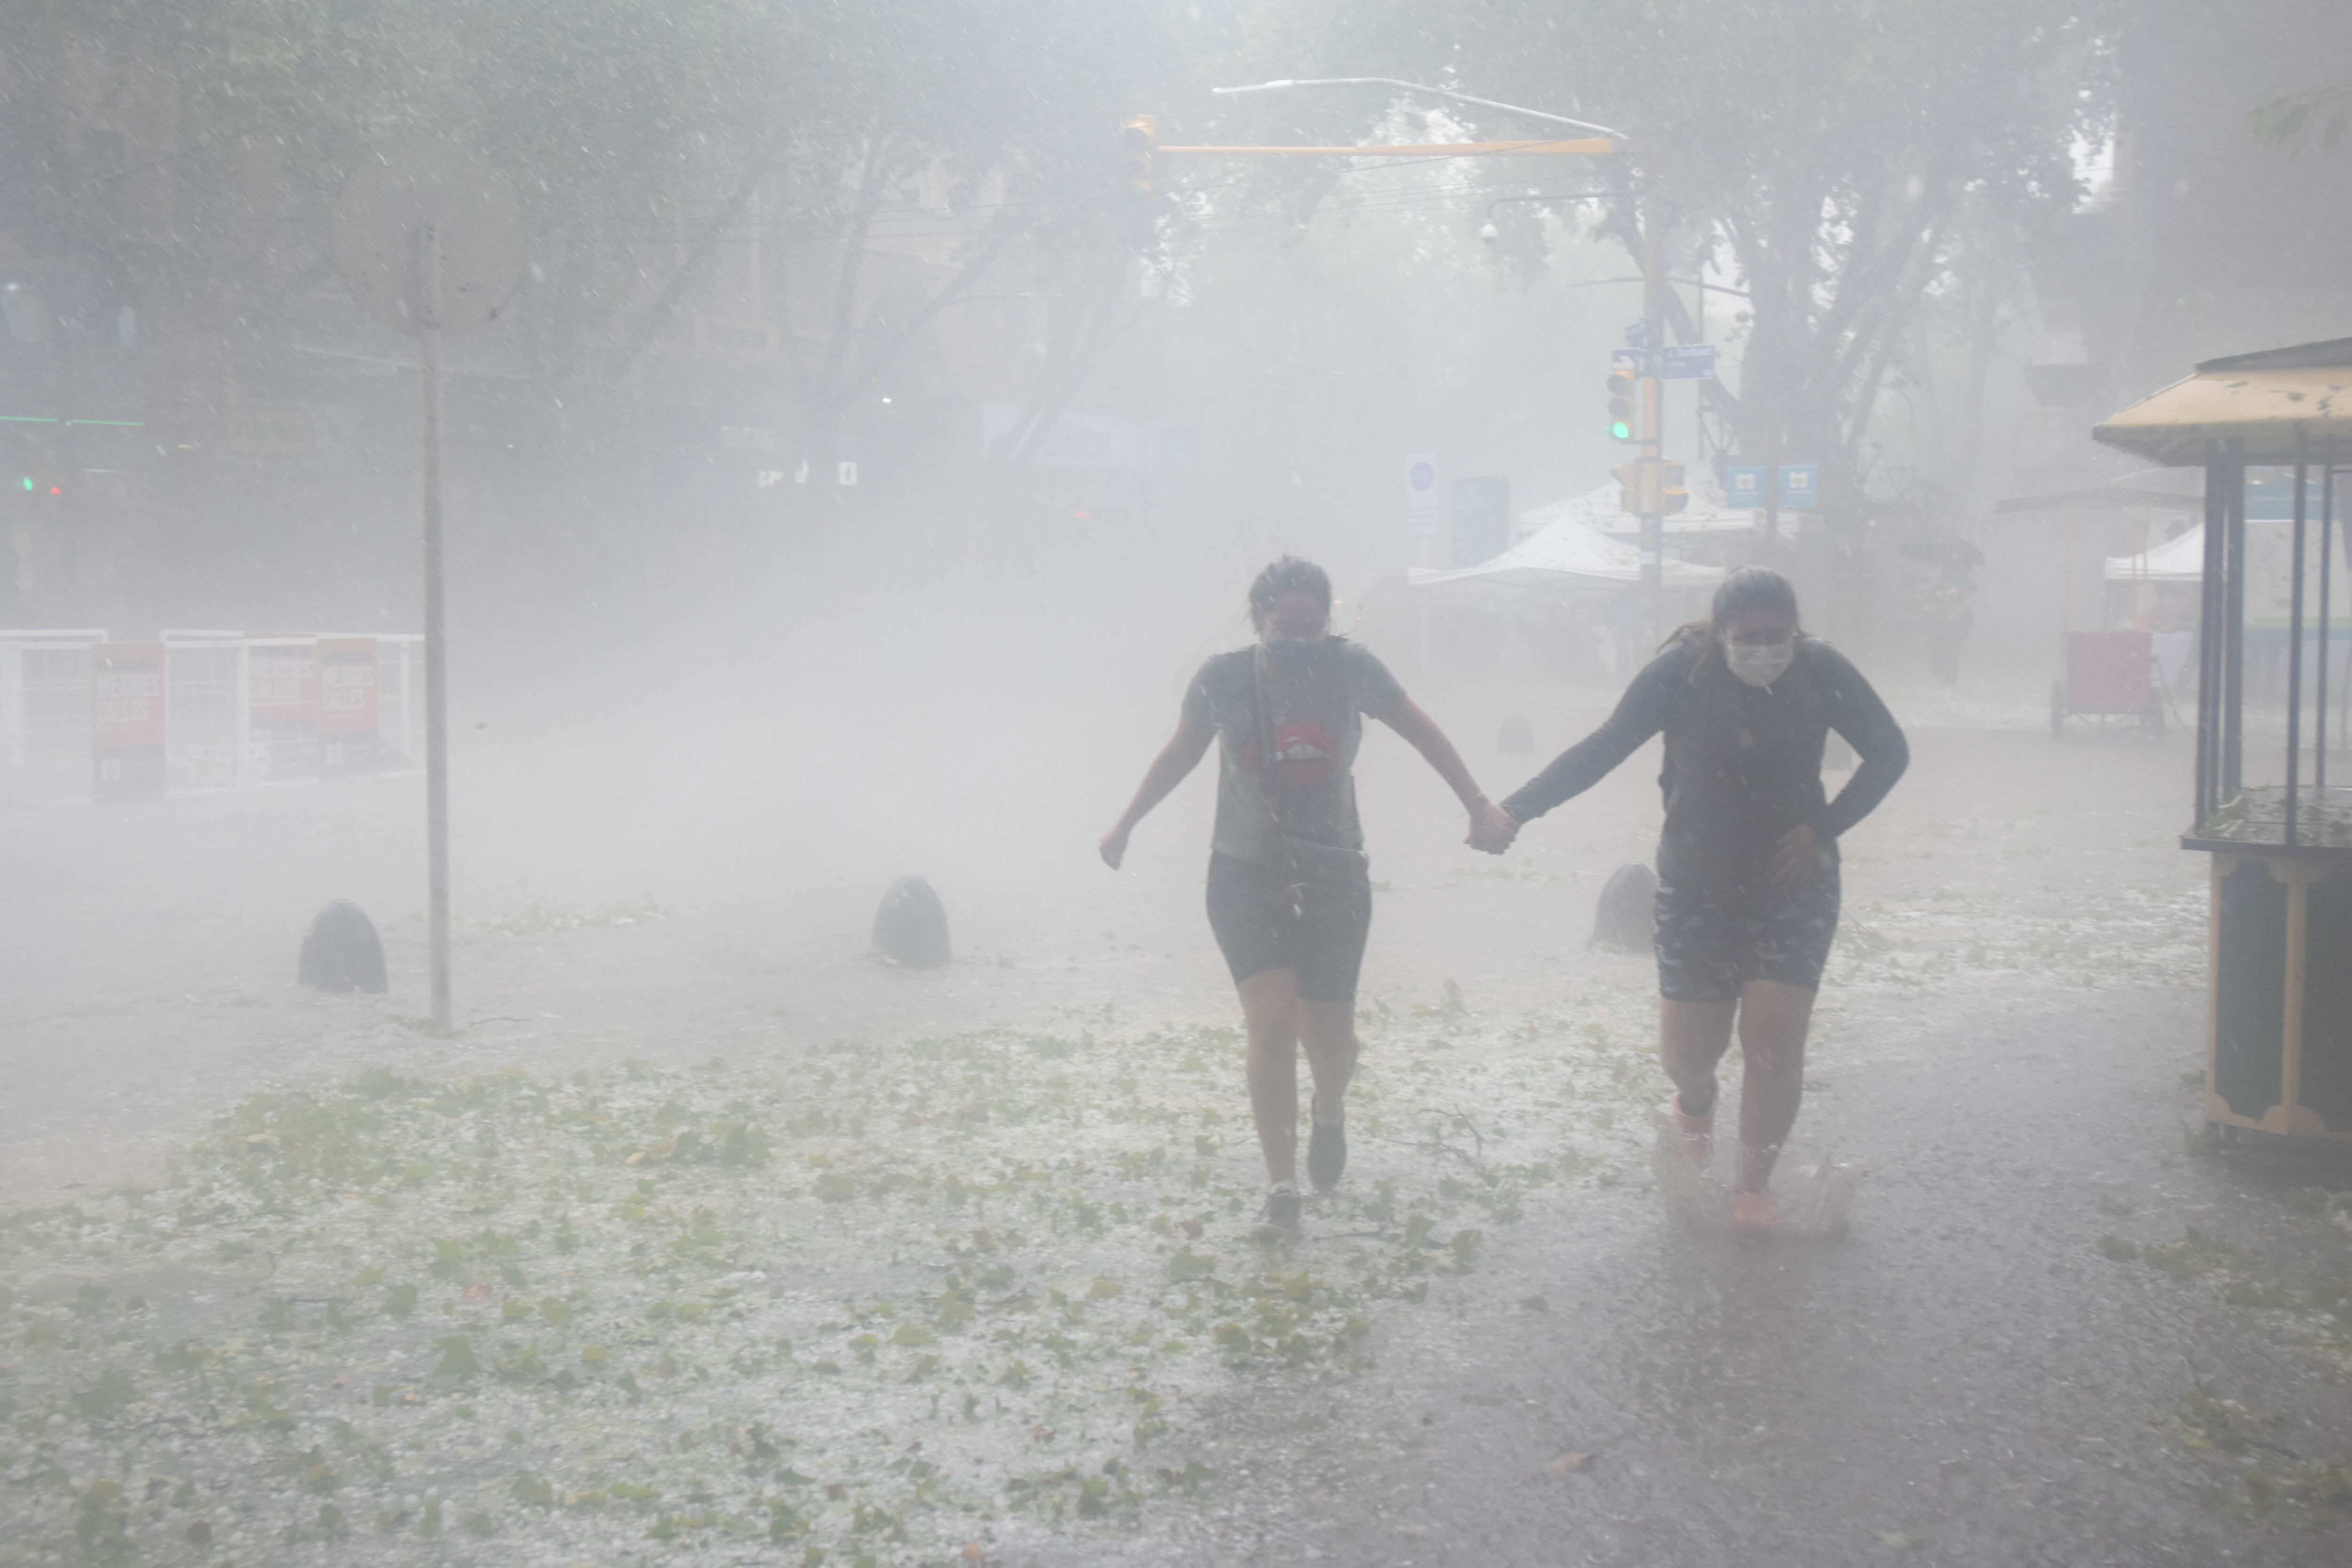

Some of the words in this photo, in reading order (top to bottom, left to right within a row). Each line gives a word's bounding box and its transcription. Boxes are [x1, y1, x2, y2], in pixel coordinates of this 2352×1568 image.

[96, 673, 160, 697] MEJORES
[96, 698, 150, 724] CALLES
[322, 688, 366, 712] CALLES
